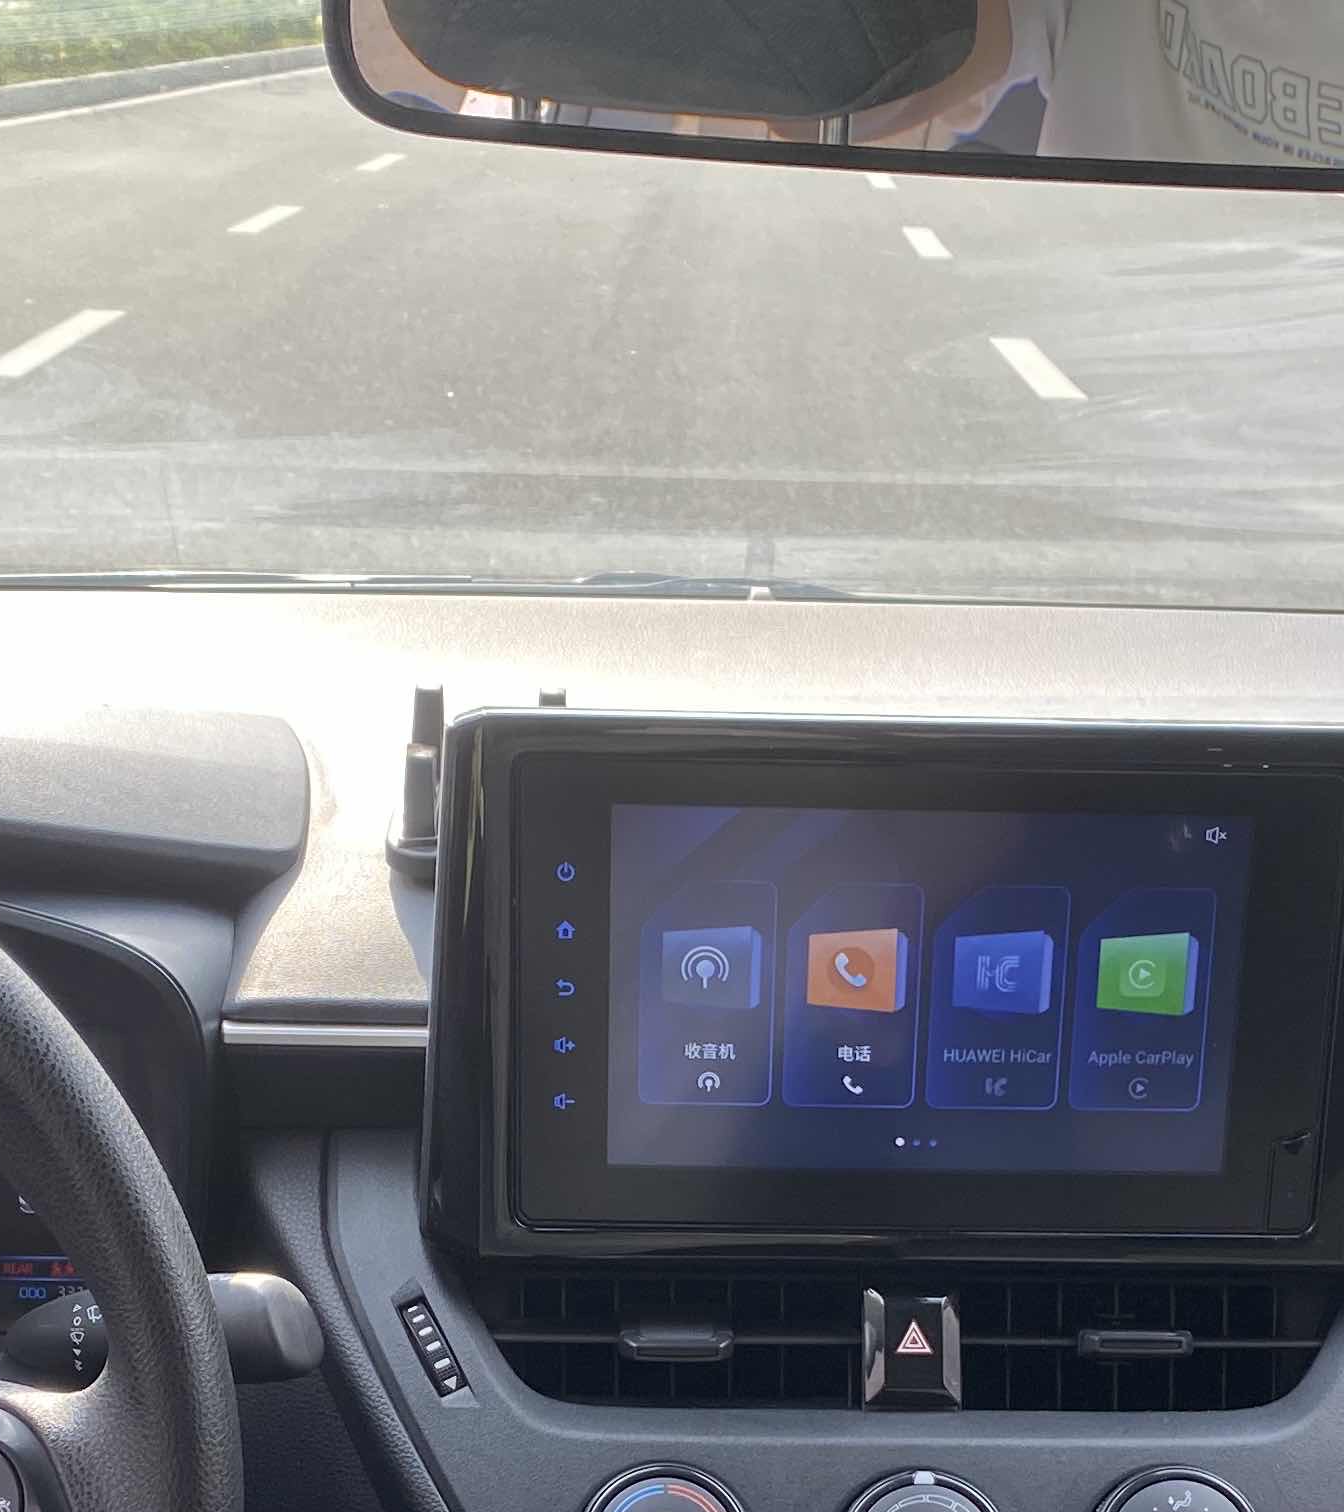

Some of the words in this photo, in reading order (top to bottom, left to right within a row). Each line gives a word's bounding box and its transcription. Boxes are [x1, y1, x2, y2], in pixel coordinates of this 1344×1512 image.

[684, 1043, 736, 1061] 收音机
[837, 1045, 872, 1063] 电话
[943, 1048, 1006, 1064] HUAWEI
[1010, 1049, 1052, 1064] HiCar
[1088, 1050, 1132, 1067] Apple
[1135, 1052, 1194, 1069] CarPlay
